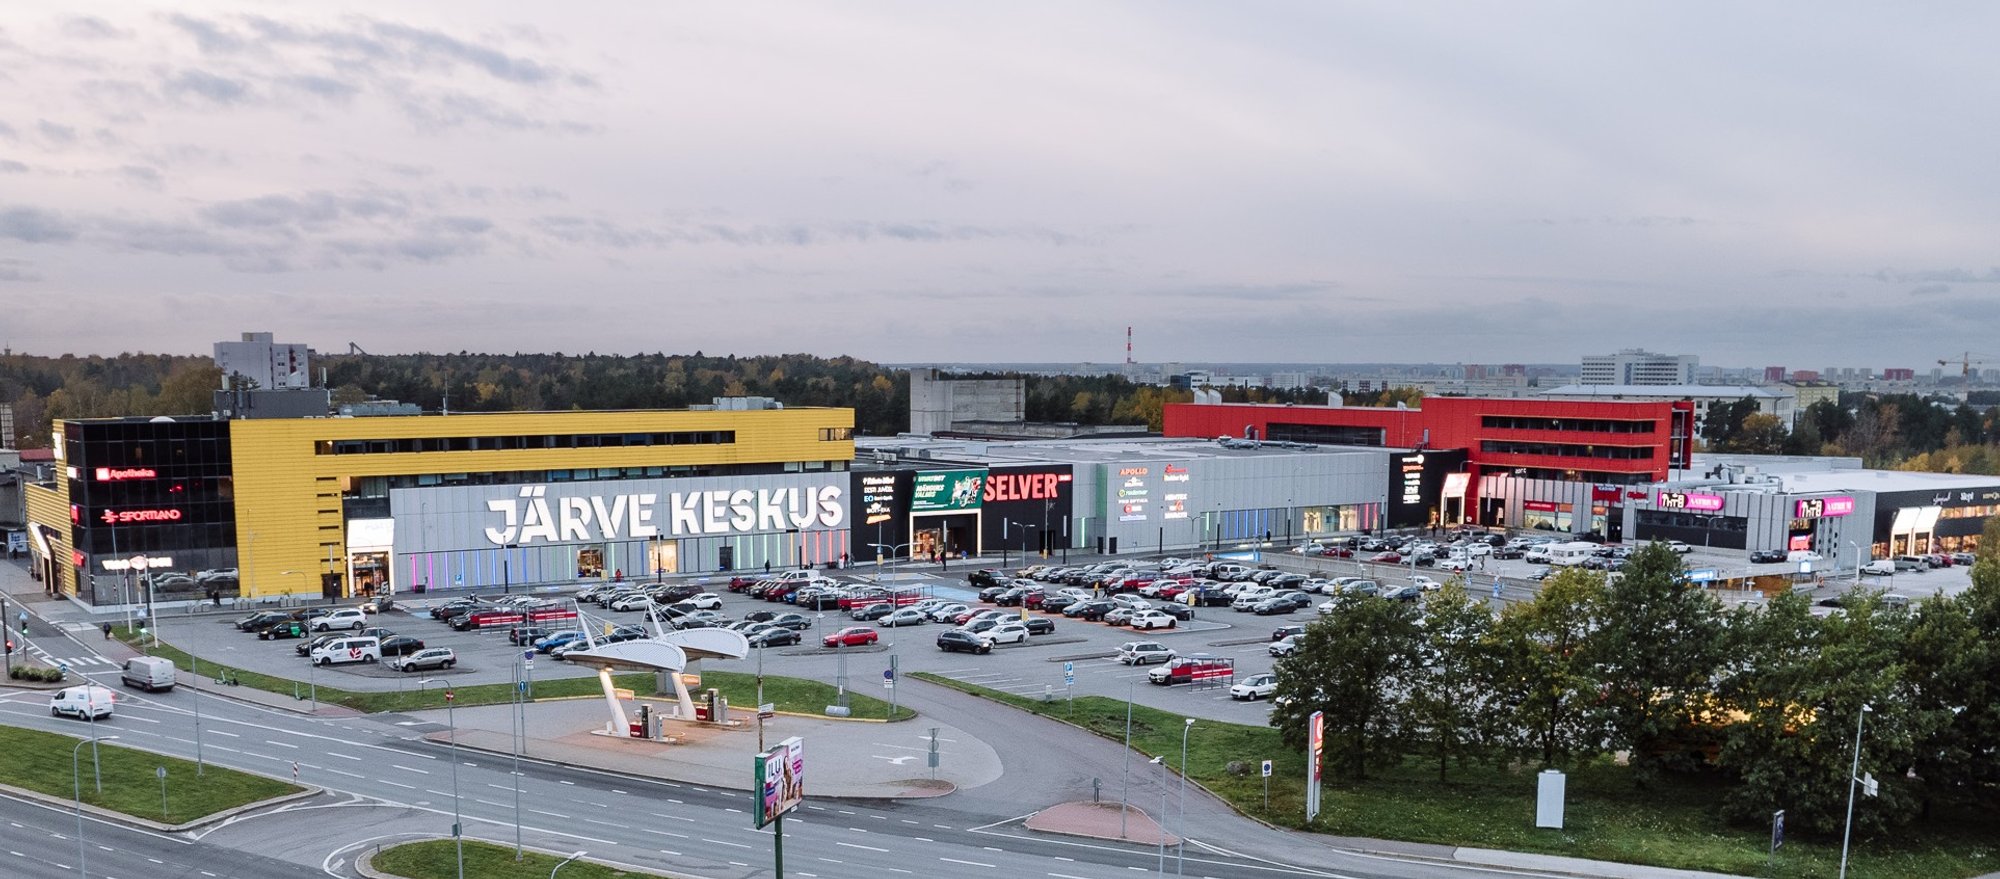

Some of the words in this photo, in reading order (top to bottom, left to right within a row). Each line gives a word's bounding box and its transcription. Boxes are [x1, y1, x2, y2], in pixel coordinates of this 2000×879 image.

[110, 468, 156, 480] Apotheka
[982, 473, 1058, 502] SELVER
[119, 509, 180, 521] SPORTLAND
[484, 485, 658, 546] JÄRVE
[669, 484, 844, 536] KESKUS
[767, 758, 781, 778] ILU
